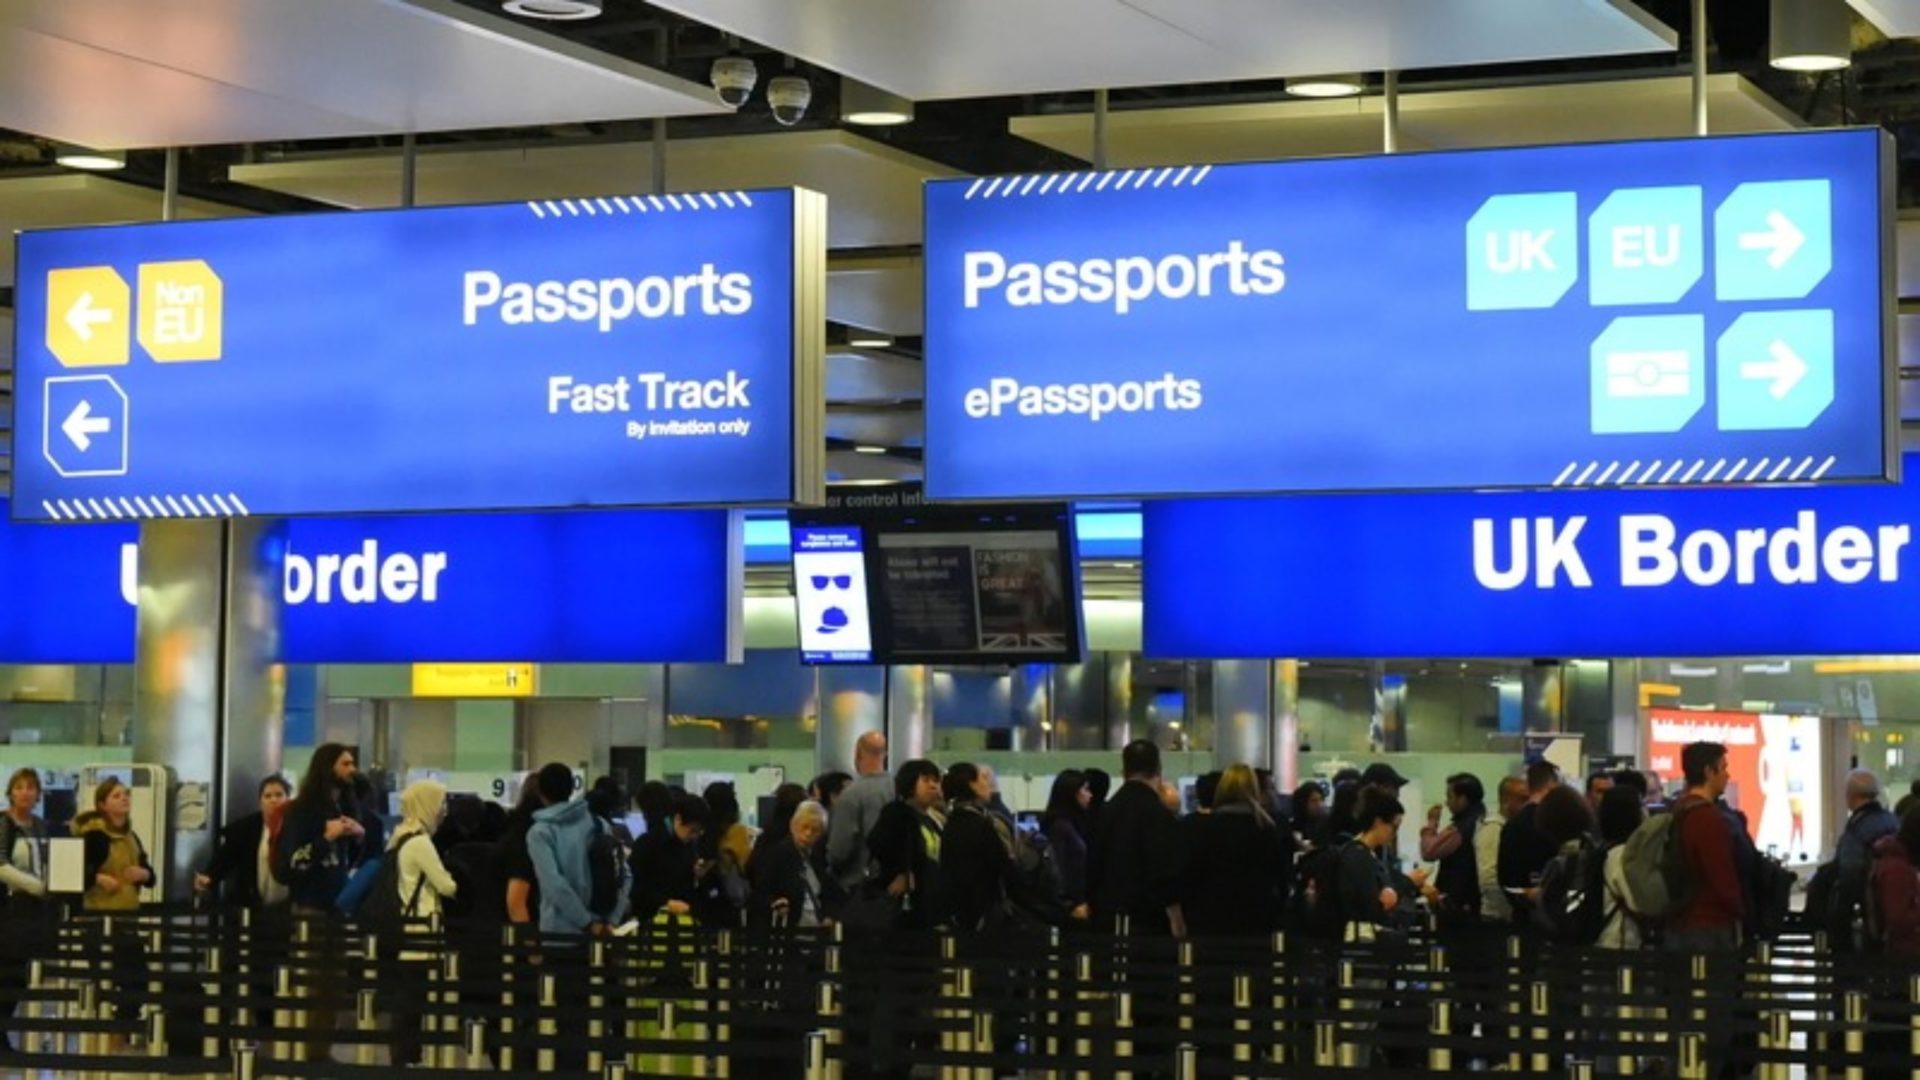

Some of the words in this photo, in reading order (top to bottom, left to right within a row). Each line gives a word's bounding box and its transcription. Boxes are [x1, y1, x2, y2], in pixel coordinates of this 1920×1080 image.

[1484, 228, 1557, 273] UK
[1612, 223, 1680, 268] EU
[155, 279, 206, 307] Non
[462, 263, 752, 332] Passports
[964, 241, 1286, 314] Passports
[154, 306, 206, 345] EU
[547, 374, 630, 413] Fast
[637, 370, 750, 411] Track
[964, 373, 1202, 421] ePassports
[626, 420, 647, 440] By
[718, 417, 751, 437] only
[845, 491, 899, 507] control
[1473, 516, 1592, 589] UK
[1620, 510, 1909, 586] Border
[492, 777, 505, 797] 9
